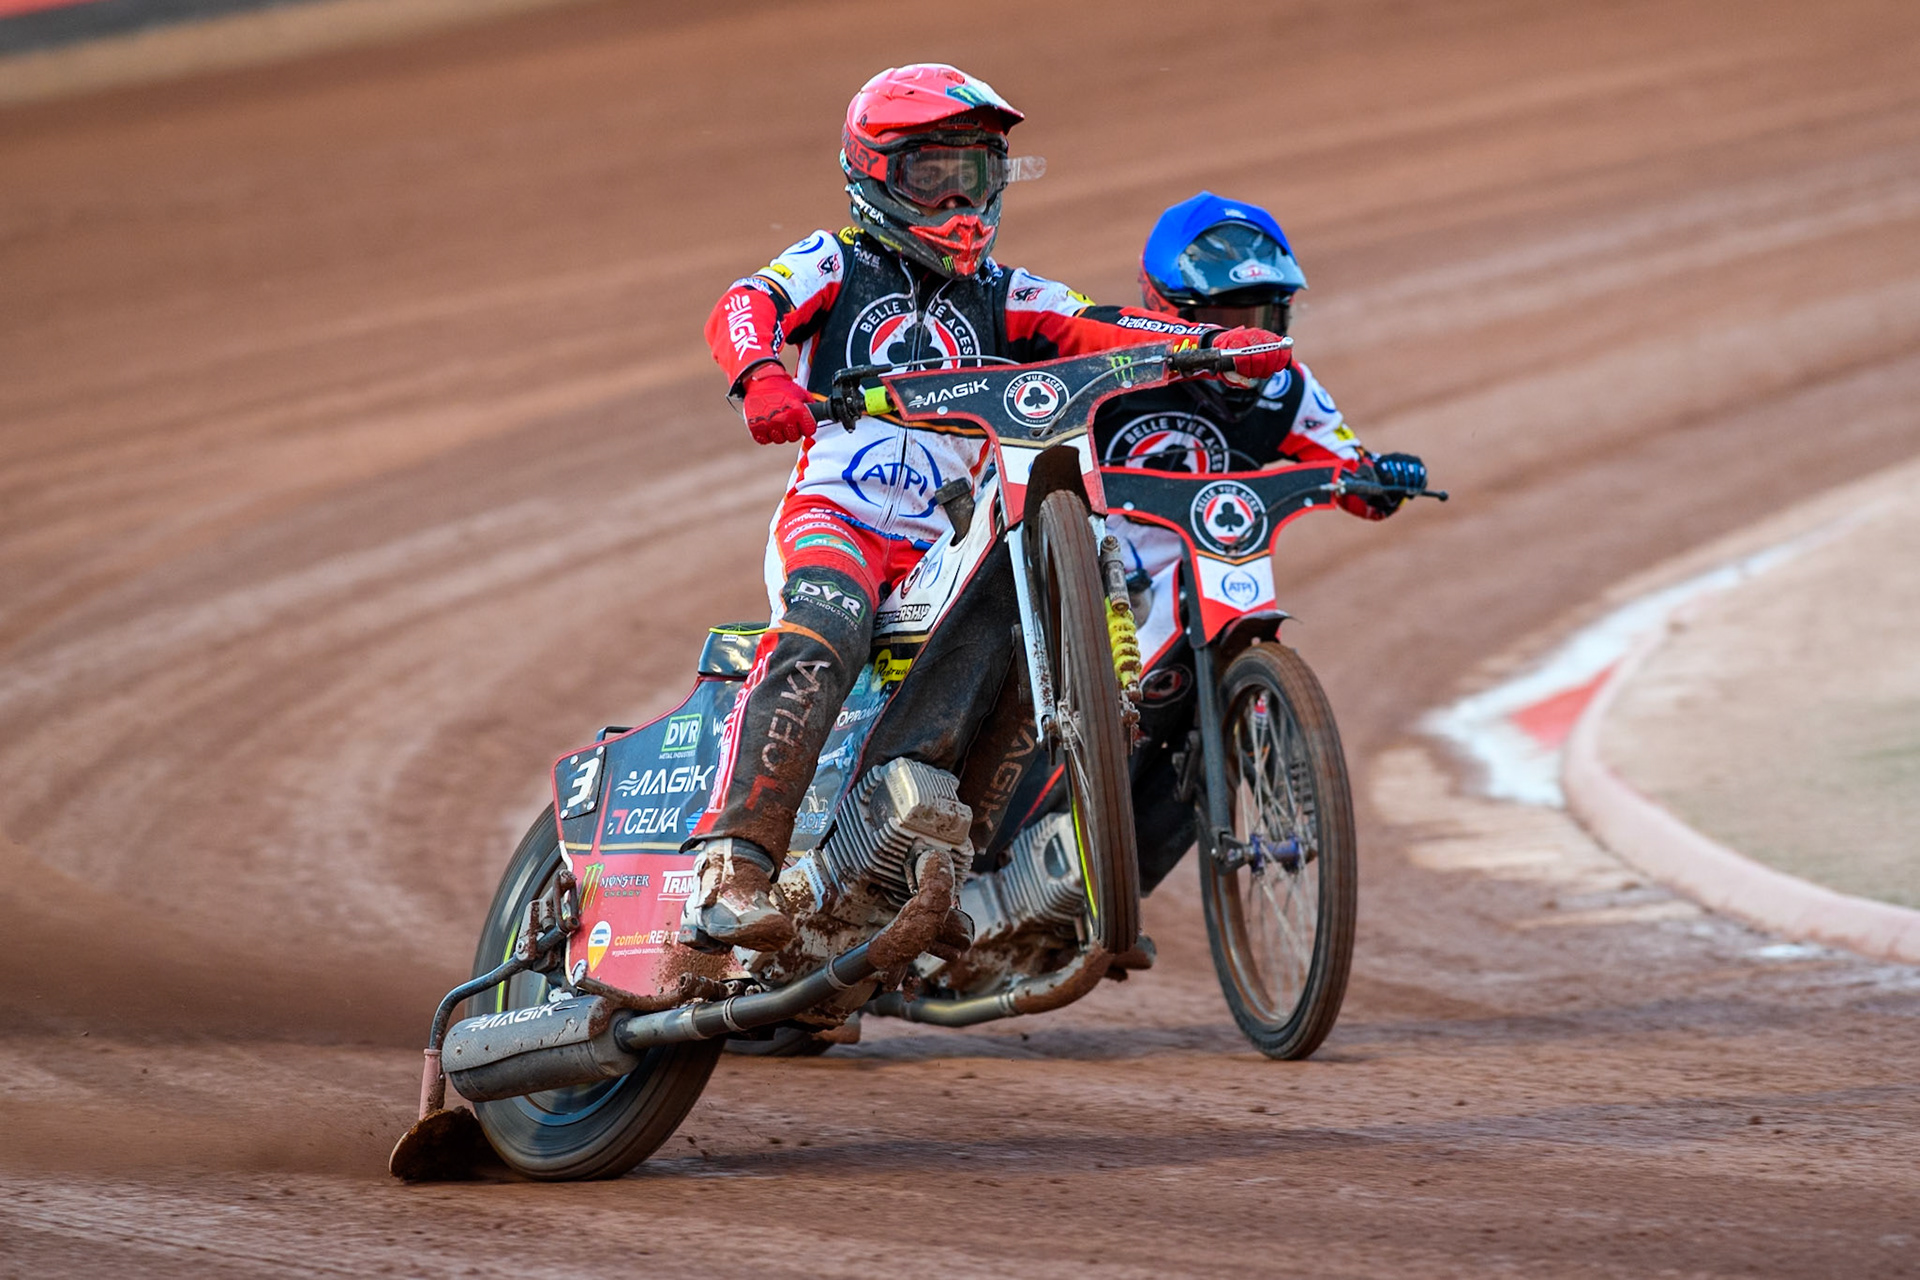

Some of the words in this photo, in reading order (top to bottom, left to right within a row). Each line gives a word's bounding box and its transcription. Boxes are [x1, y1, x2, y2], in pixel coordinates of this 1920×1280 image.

[860, 301, 901, 333] BELLE
[945, 318, 974, 355] ACES
[1008, 379, 1025, 398] BELLE
[1045, 377, 1063, 392] ACES
[1124, 418, 1169, 444] BELLE
[1176, 419, 1207, 436] VUE
[861, 462, 928, 496] ATPI
[1196, 488, 1218, 513] BELLE
[1218, 486, 1238, 494] VUE
[1240, 490, 1261, 512] ACES
[797, 581, 861, 618] DVR
[1228, 582, 1253, 592] ATPI
[761, 660, 832, 773] CELKA
[665, 719, 699, 746] DVR
[567, 757, 600, 809] 3
[624, 806, 681, 835] CELKA
[601, 873, 650, 888] MONSTER
[604, 889, 642, 898] ENERGY
